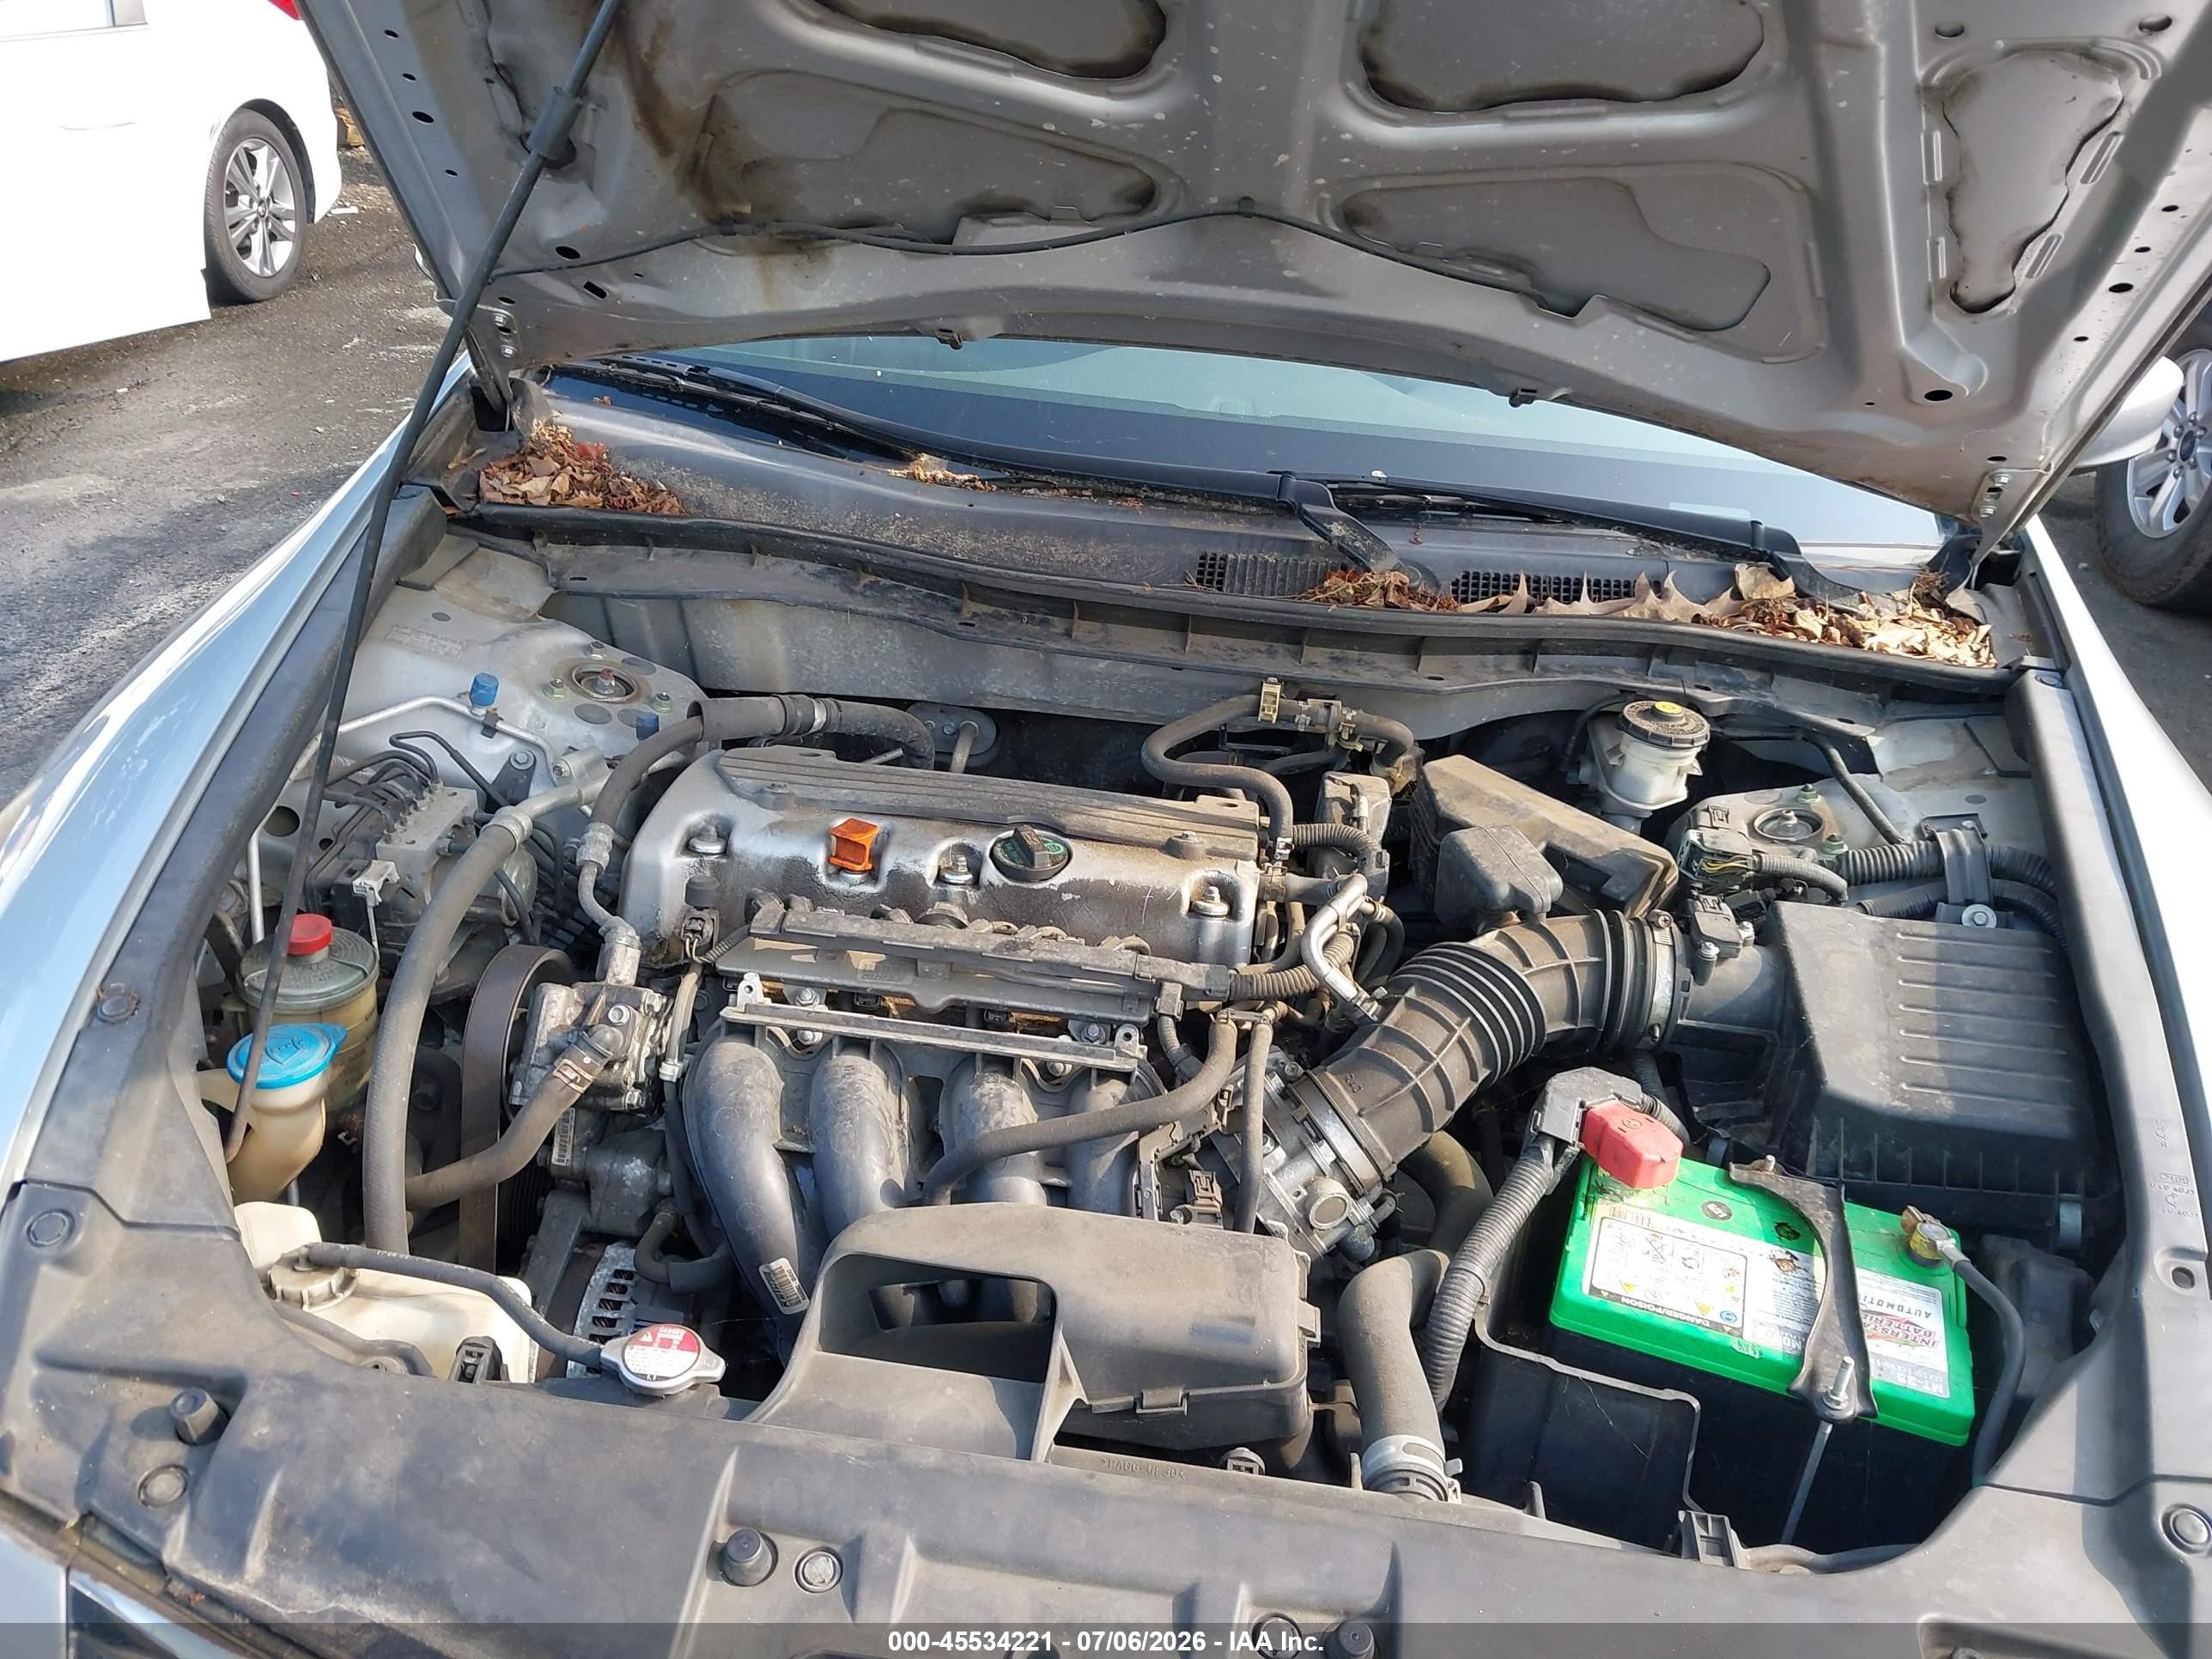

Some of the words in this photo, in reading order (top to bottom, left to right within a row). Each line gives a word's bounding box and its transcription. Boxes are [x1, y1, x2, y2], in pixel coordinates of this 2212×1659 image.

[1621, 1297, 1710, 1327] DANGER/POISON
[1858, 1293, 1932, 1319] AUTOMOTI
[1861, 1312, 1934, 1338] BATTERIE
[1863, 1322, 1936, 1347] INTERSTA
